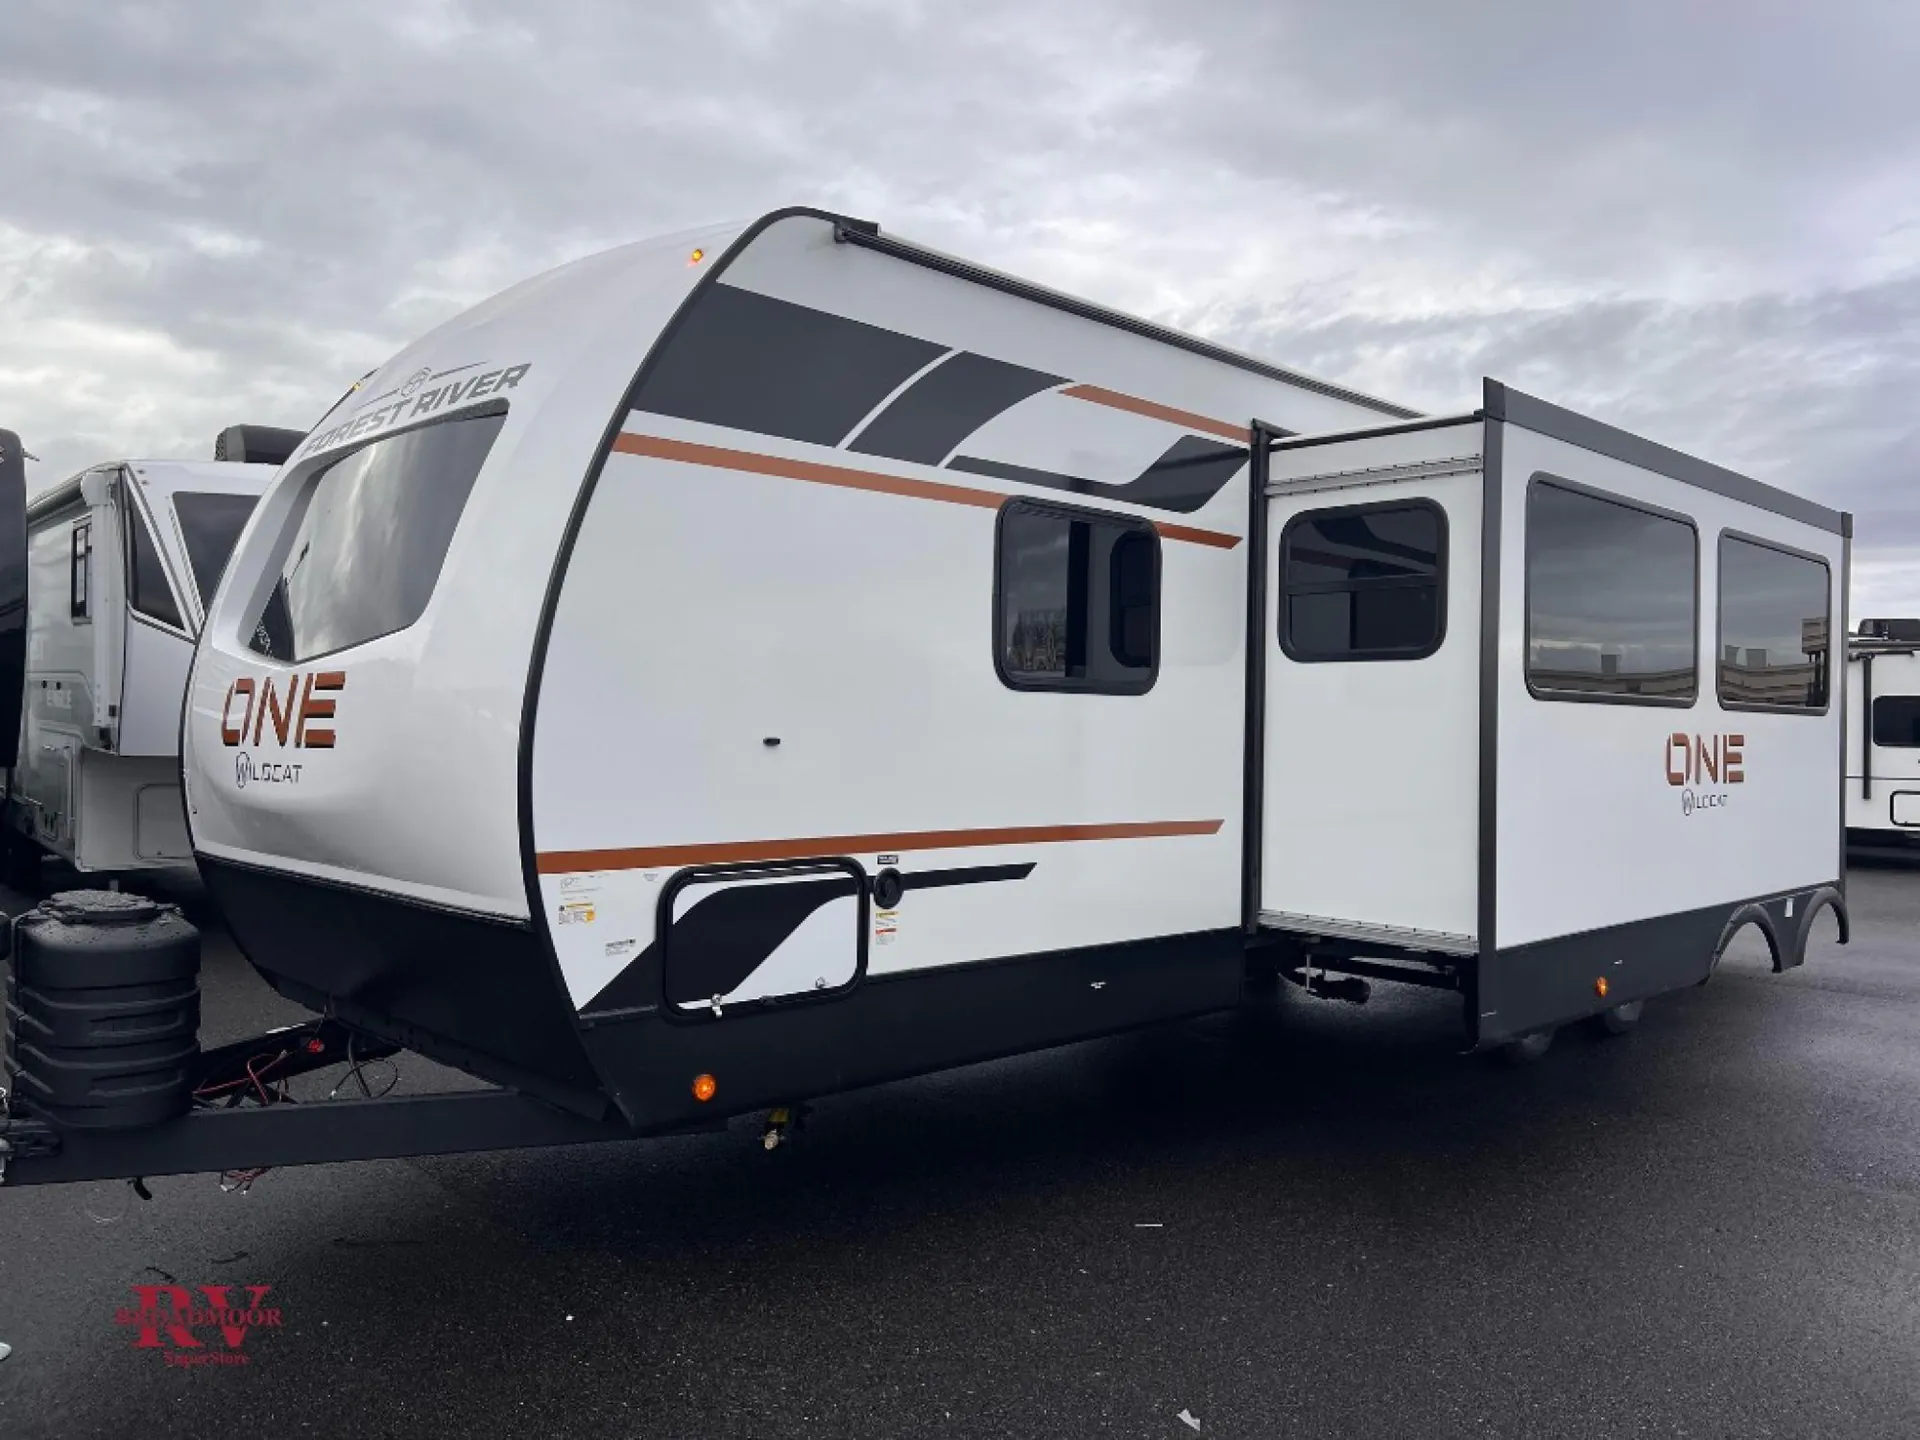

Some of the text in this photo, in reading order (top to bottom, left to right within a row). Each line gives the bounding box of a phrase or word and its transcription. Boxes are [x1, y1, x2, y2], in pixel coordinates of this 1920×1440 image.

[299, 362, 532, 457] FOREST RIVER
[221, 671, 346, 749] ONE
[235, 751, 303, 789] WILDCAT
[1665, 733, 1744, 785] ONE
